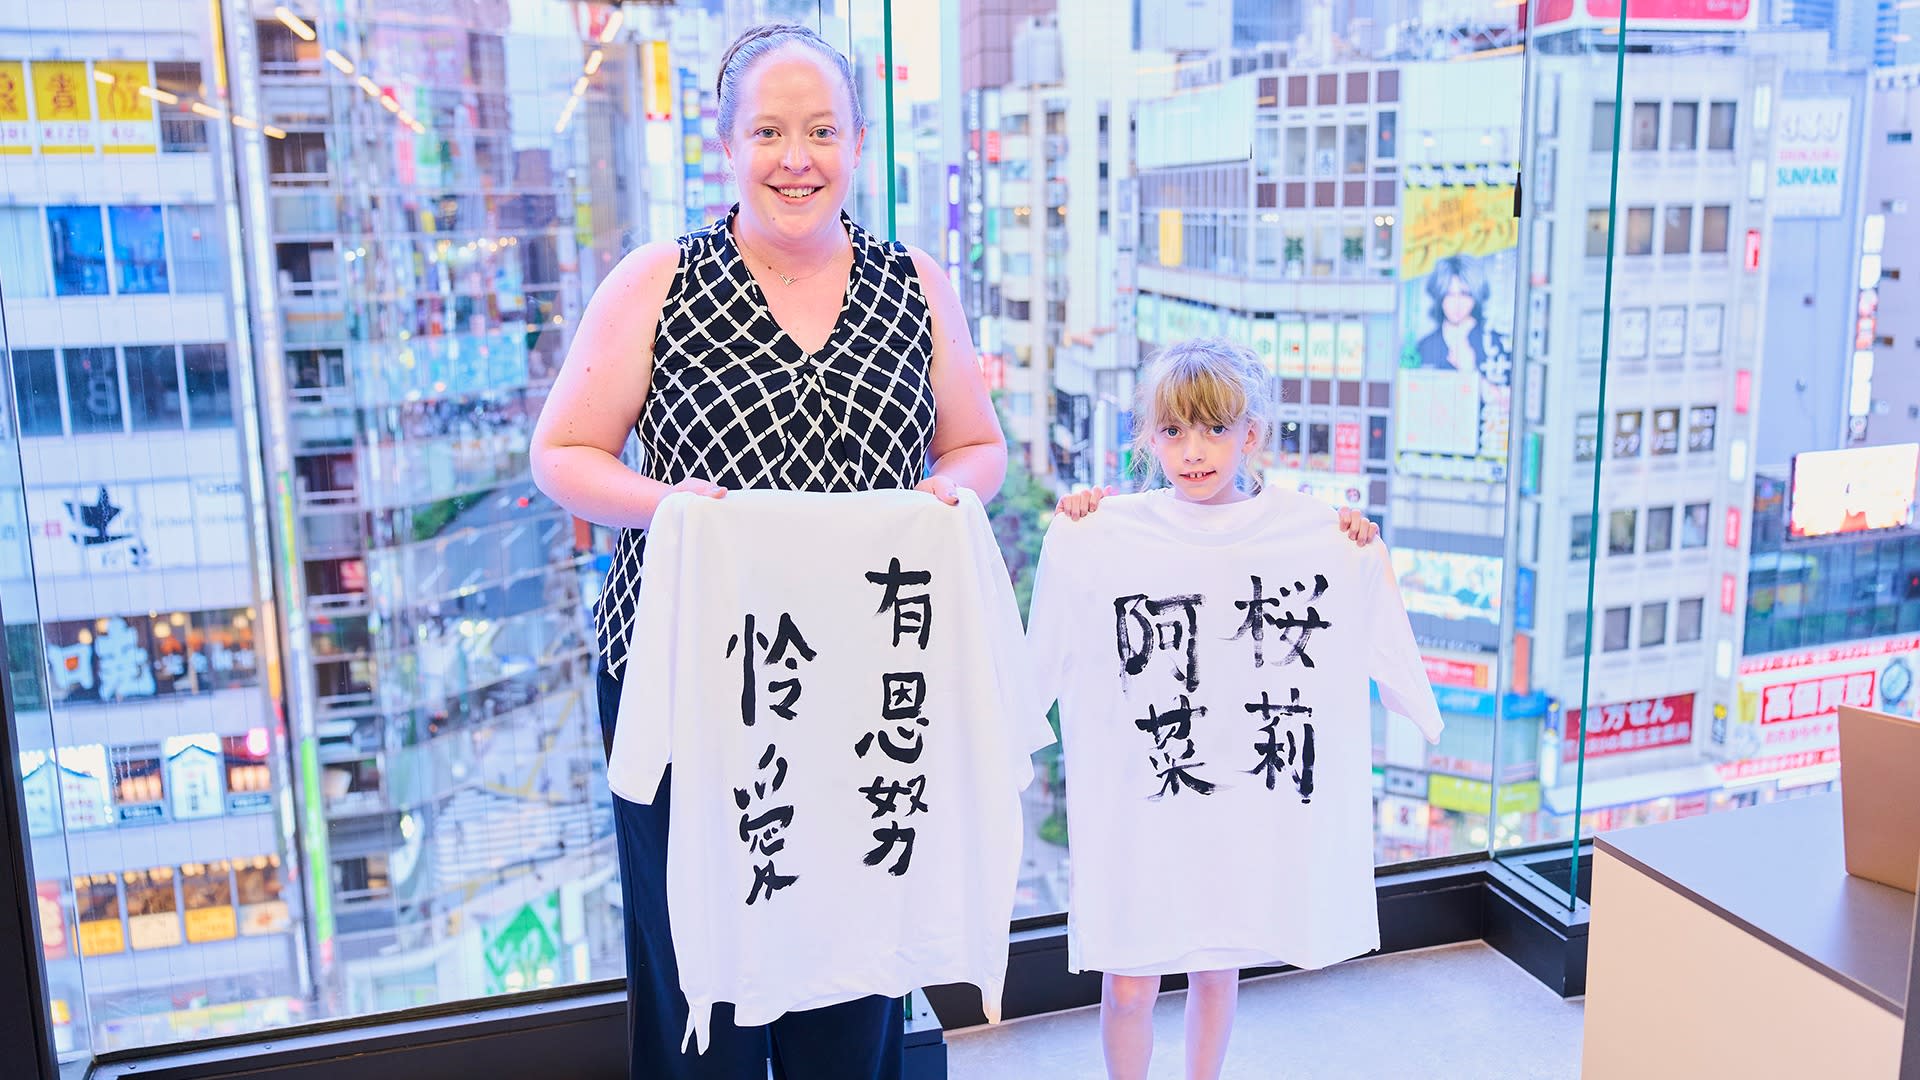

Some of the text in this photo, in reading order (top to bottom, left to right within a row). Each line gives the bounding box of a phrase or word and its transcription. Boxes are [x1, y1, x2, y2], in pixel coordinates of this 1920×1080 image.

[1777, 167, 1838, 187] SUNPARK
[855, 557, 932, 876] 有恩努力
[1113, 593, 1228, 801] 阿菜
[1219, 574, 1332, 804] 桜莉
[1765, 672, 1873, 721] 高価買取
